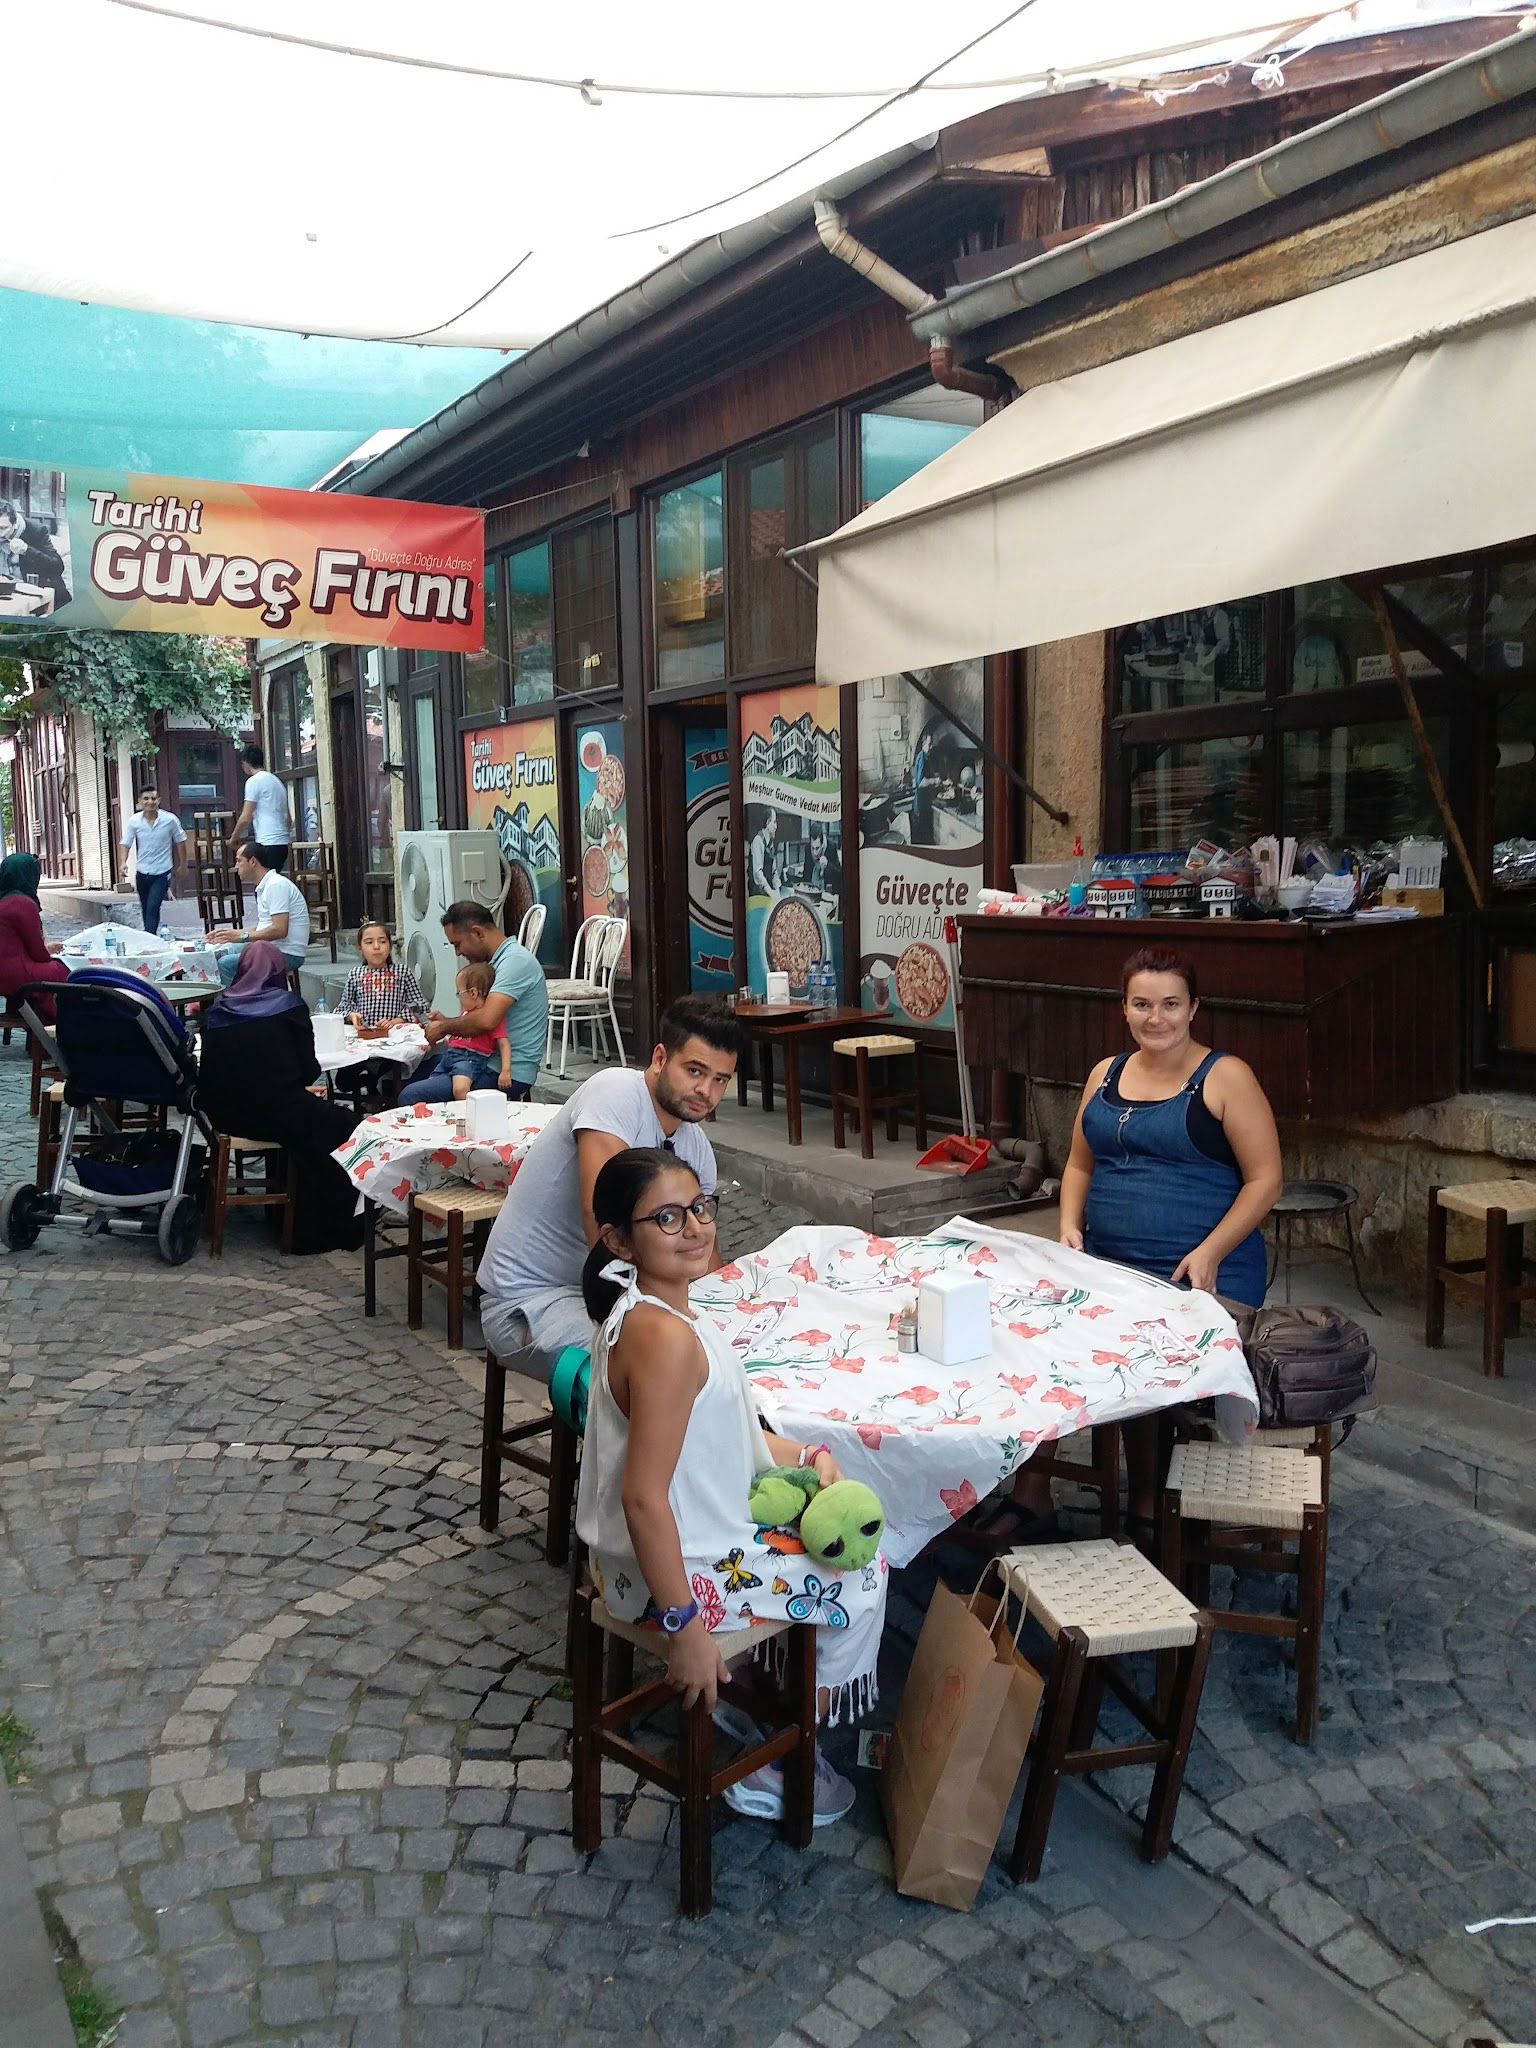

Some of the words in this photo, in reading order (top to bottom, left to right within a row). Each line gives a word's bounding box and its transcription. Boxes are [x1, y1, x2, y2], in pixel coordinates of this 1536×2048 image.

[88, 490, 203, 534] Tarihi
[91, 530, 300, 627] Güveç
[311, 548, 472, 623] Fırını
[413, 551, 444, 571] Doğru
[470, 737, 493, 758] Tarihi
[472, 758, 513, 798] Güveç
[515, 751, 554, 788] Fırını
[748, 780, 774, 796] Meşhur
[775, 787, 798, 807] Gurme
[799, 796, 820, 814] Vedat
[876, 874, 969, 915] Güveçte
[875, 911, 921, 939] DOĞRU
